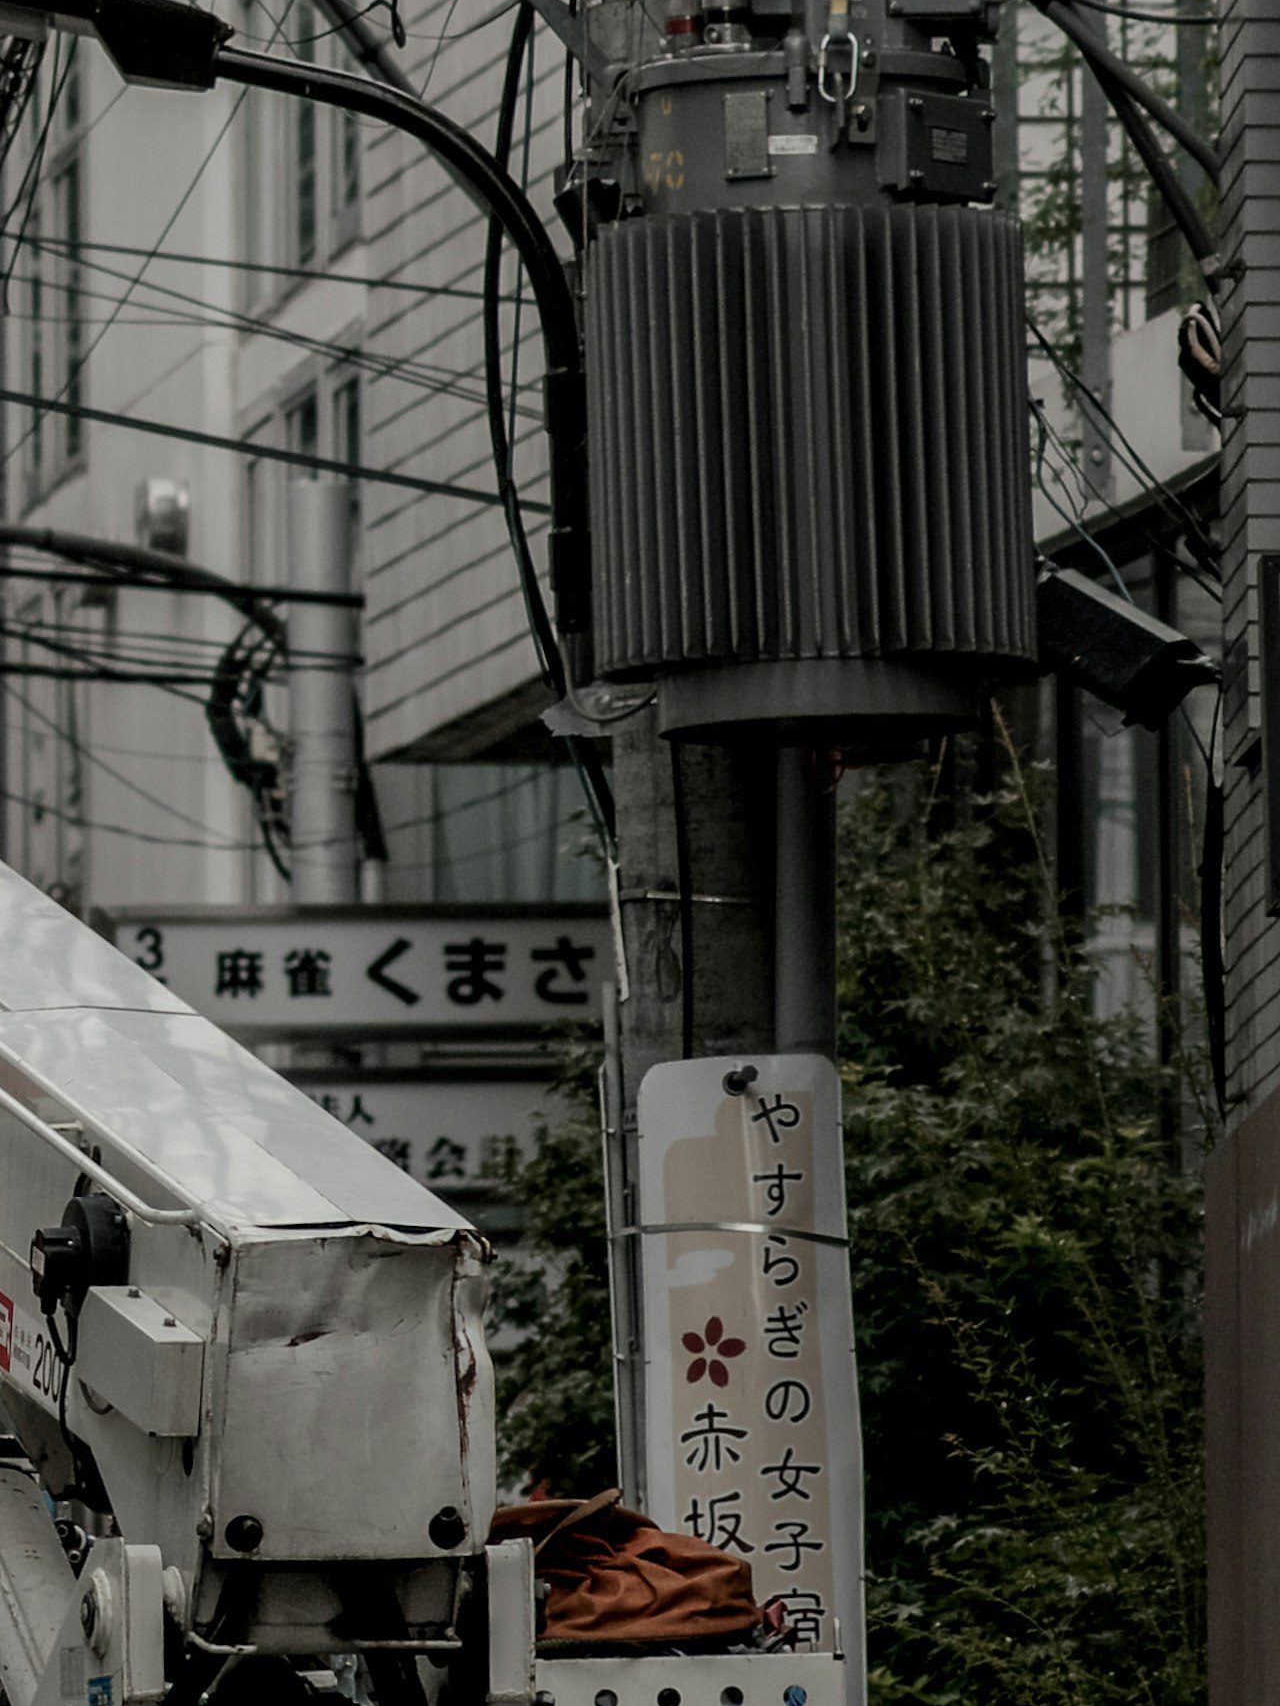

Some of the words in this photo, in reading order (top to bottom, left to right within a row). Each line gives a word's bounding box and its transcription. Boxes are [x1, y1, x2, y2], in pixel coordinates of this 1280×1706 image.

[217, 948, 332, 998] 麻雀
[368, 938, 594, 1006] くまさ
[680, 1403, 755, 1554] 赤坂
